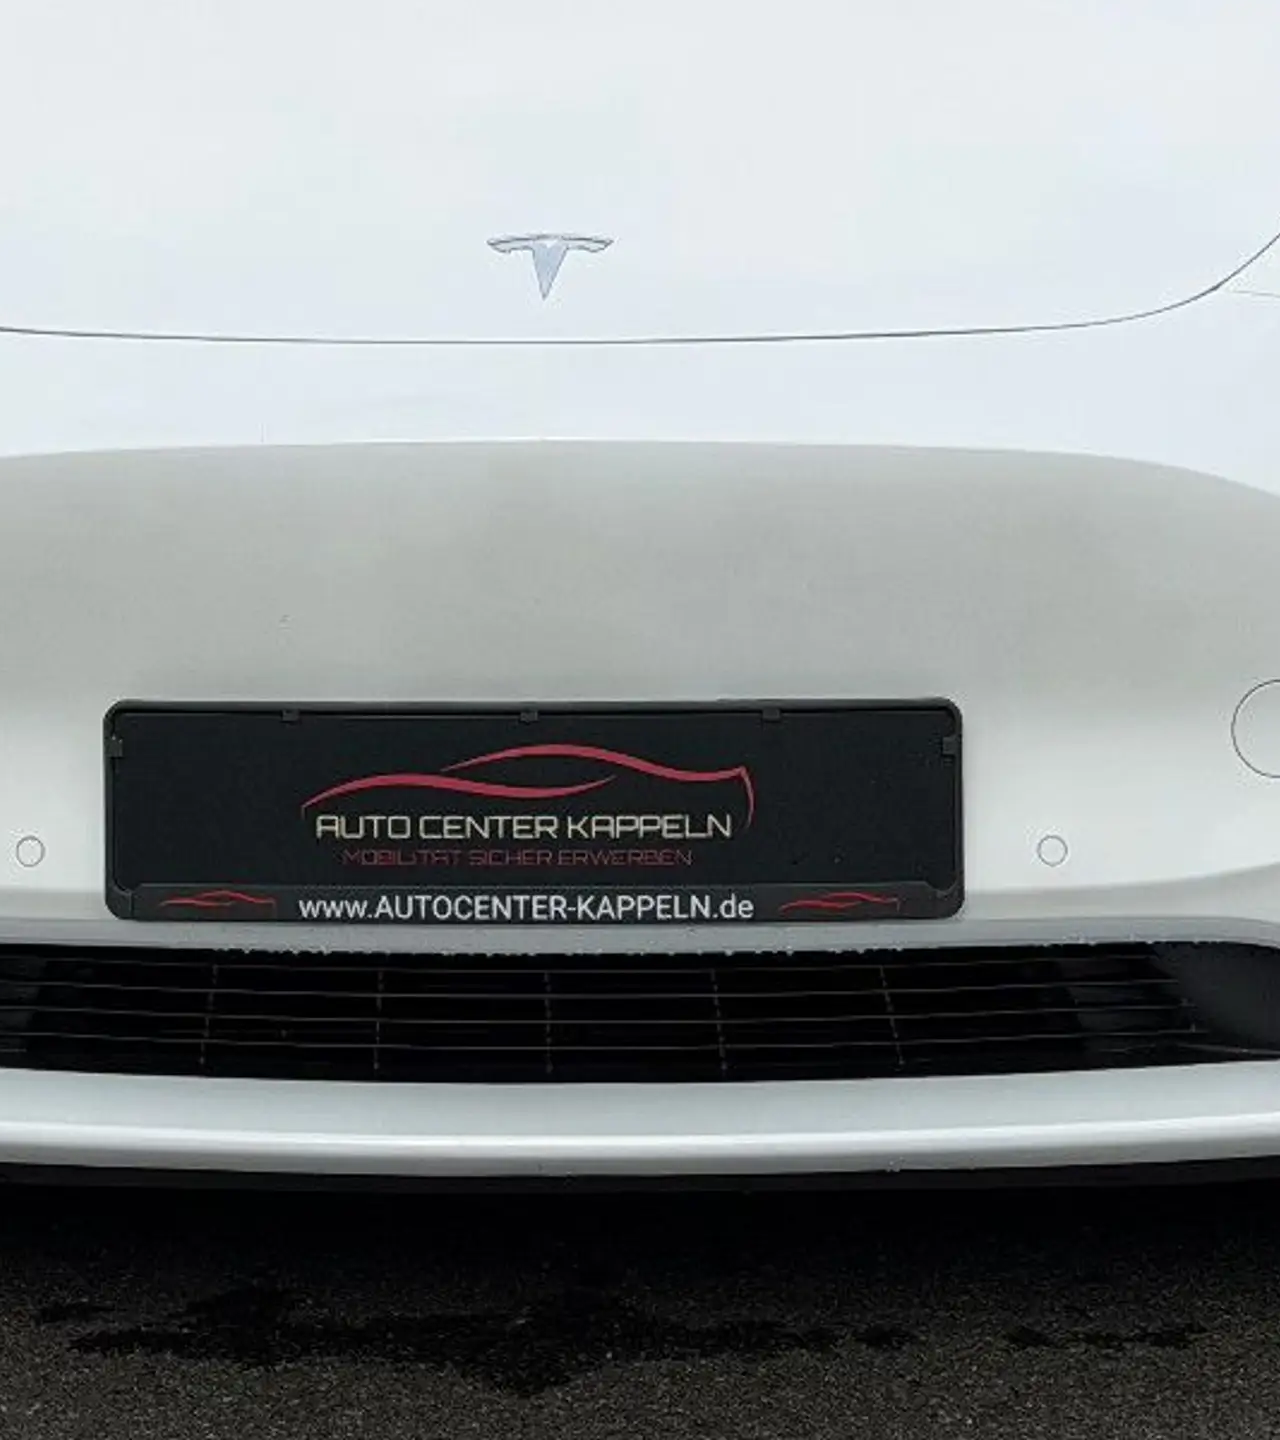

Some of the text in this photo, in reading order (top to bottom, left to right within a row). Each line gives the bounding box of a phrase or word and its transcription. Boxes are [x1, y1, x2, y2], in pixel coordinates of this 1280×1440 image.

[316, 814, 731, 839] AUTO CENTER KAPPELN
[469, 848, 552, 866] SICHER
[557, 848, 693, 866] ERWERBEN
[298, 893, 754, 920] www.AUTOCENTER-KAPPELN.de
